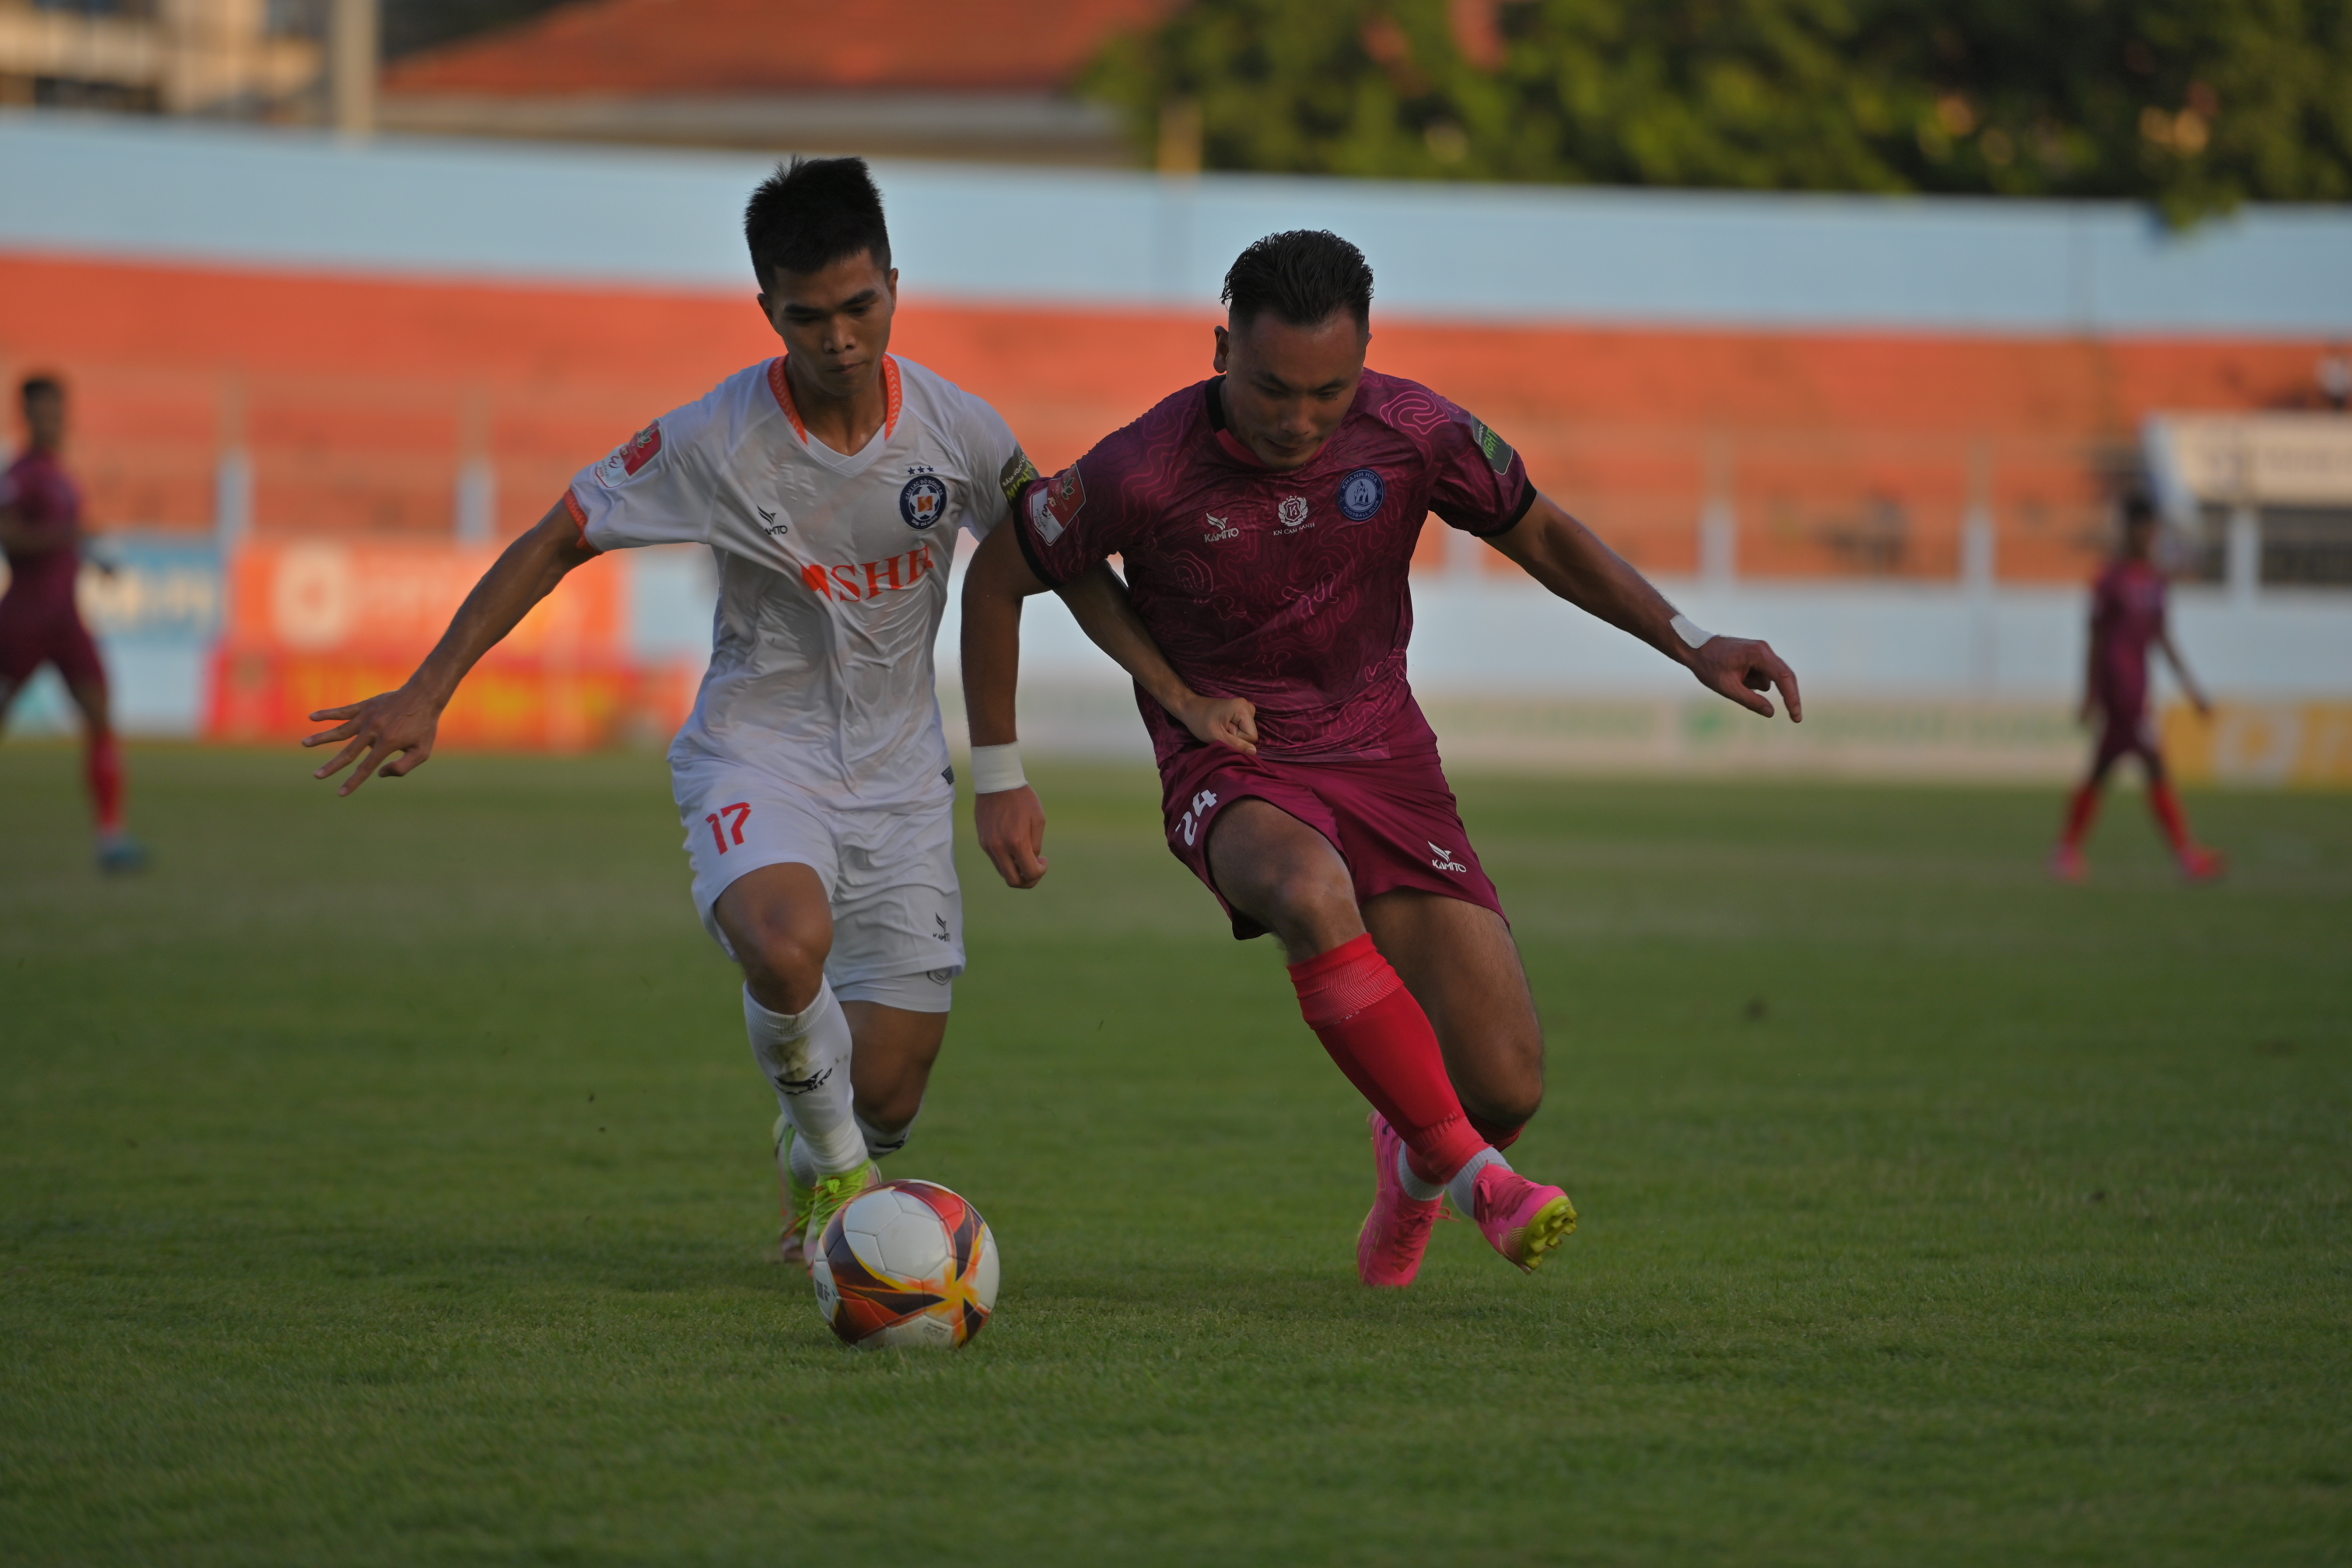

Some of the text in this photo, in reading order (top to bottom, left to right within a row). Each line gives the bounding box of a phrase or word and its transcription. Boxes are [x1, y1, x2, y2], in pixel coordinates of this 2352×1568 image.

[765, 525, 788, 536] AMITO
[1204, 527, 1239, 543] KAMITO
[1175, 789, 1217, 846] 24
[705, 802, 752, 856] 17
[1432, 859, 1467, 873] KAMITO
